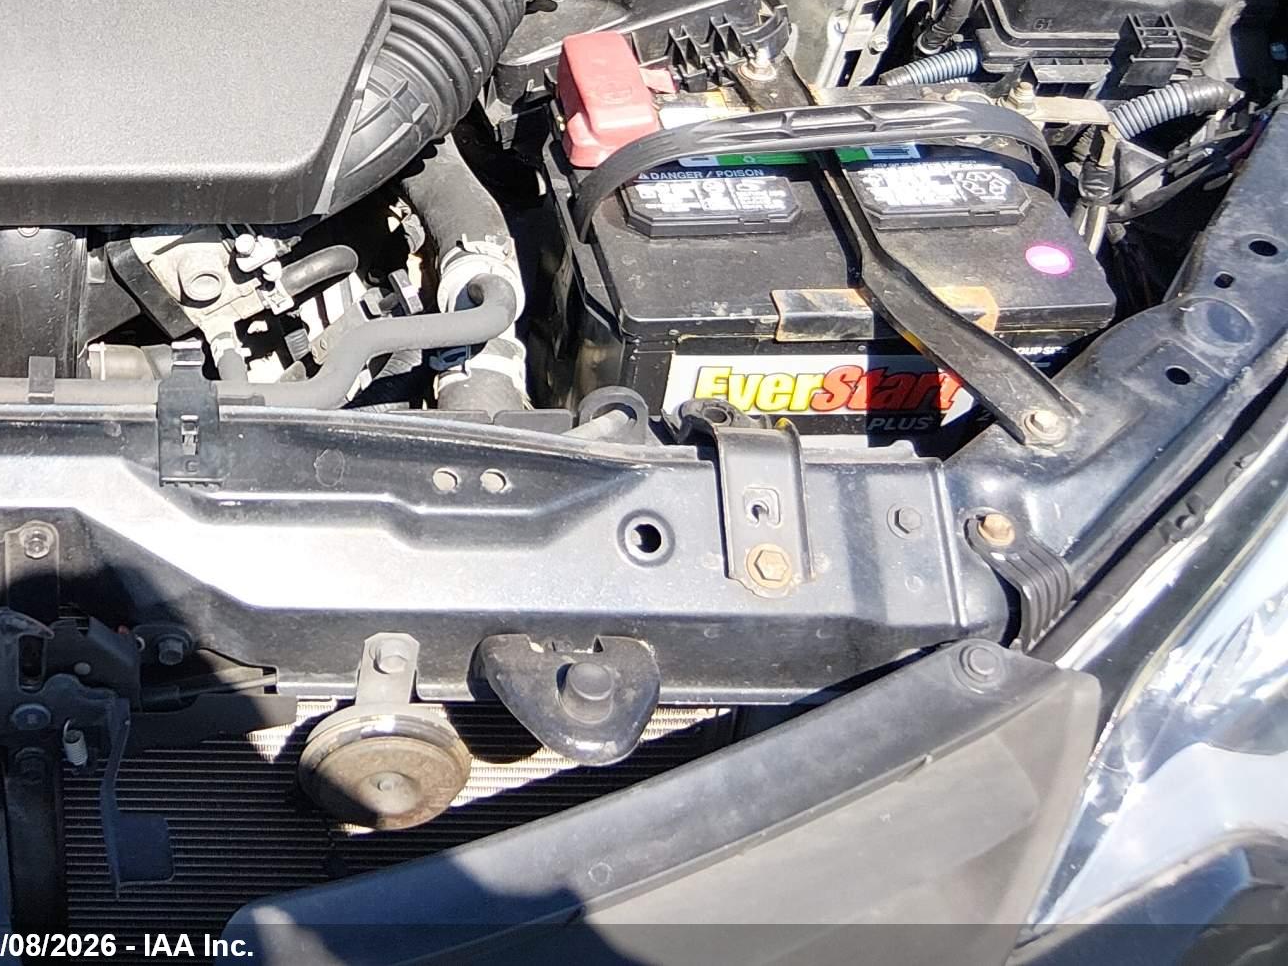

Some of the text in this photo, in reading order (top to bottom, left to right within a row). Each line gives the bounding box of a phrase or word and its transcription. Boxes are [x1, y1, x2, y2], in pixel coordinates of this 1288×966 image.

[650, 170, 703, 181] DANGER
[715, 168, 765, 179] POISON
[694, 365, 964, 412] EverStart
[867, 416, 929, 431] PLUS
